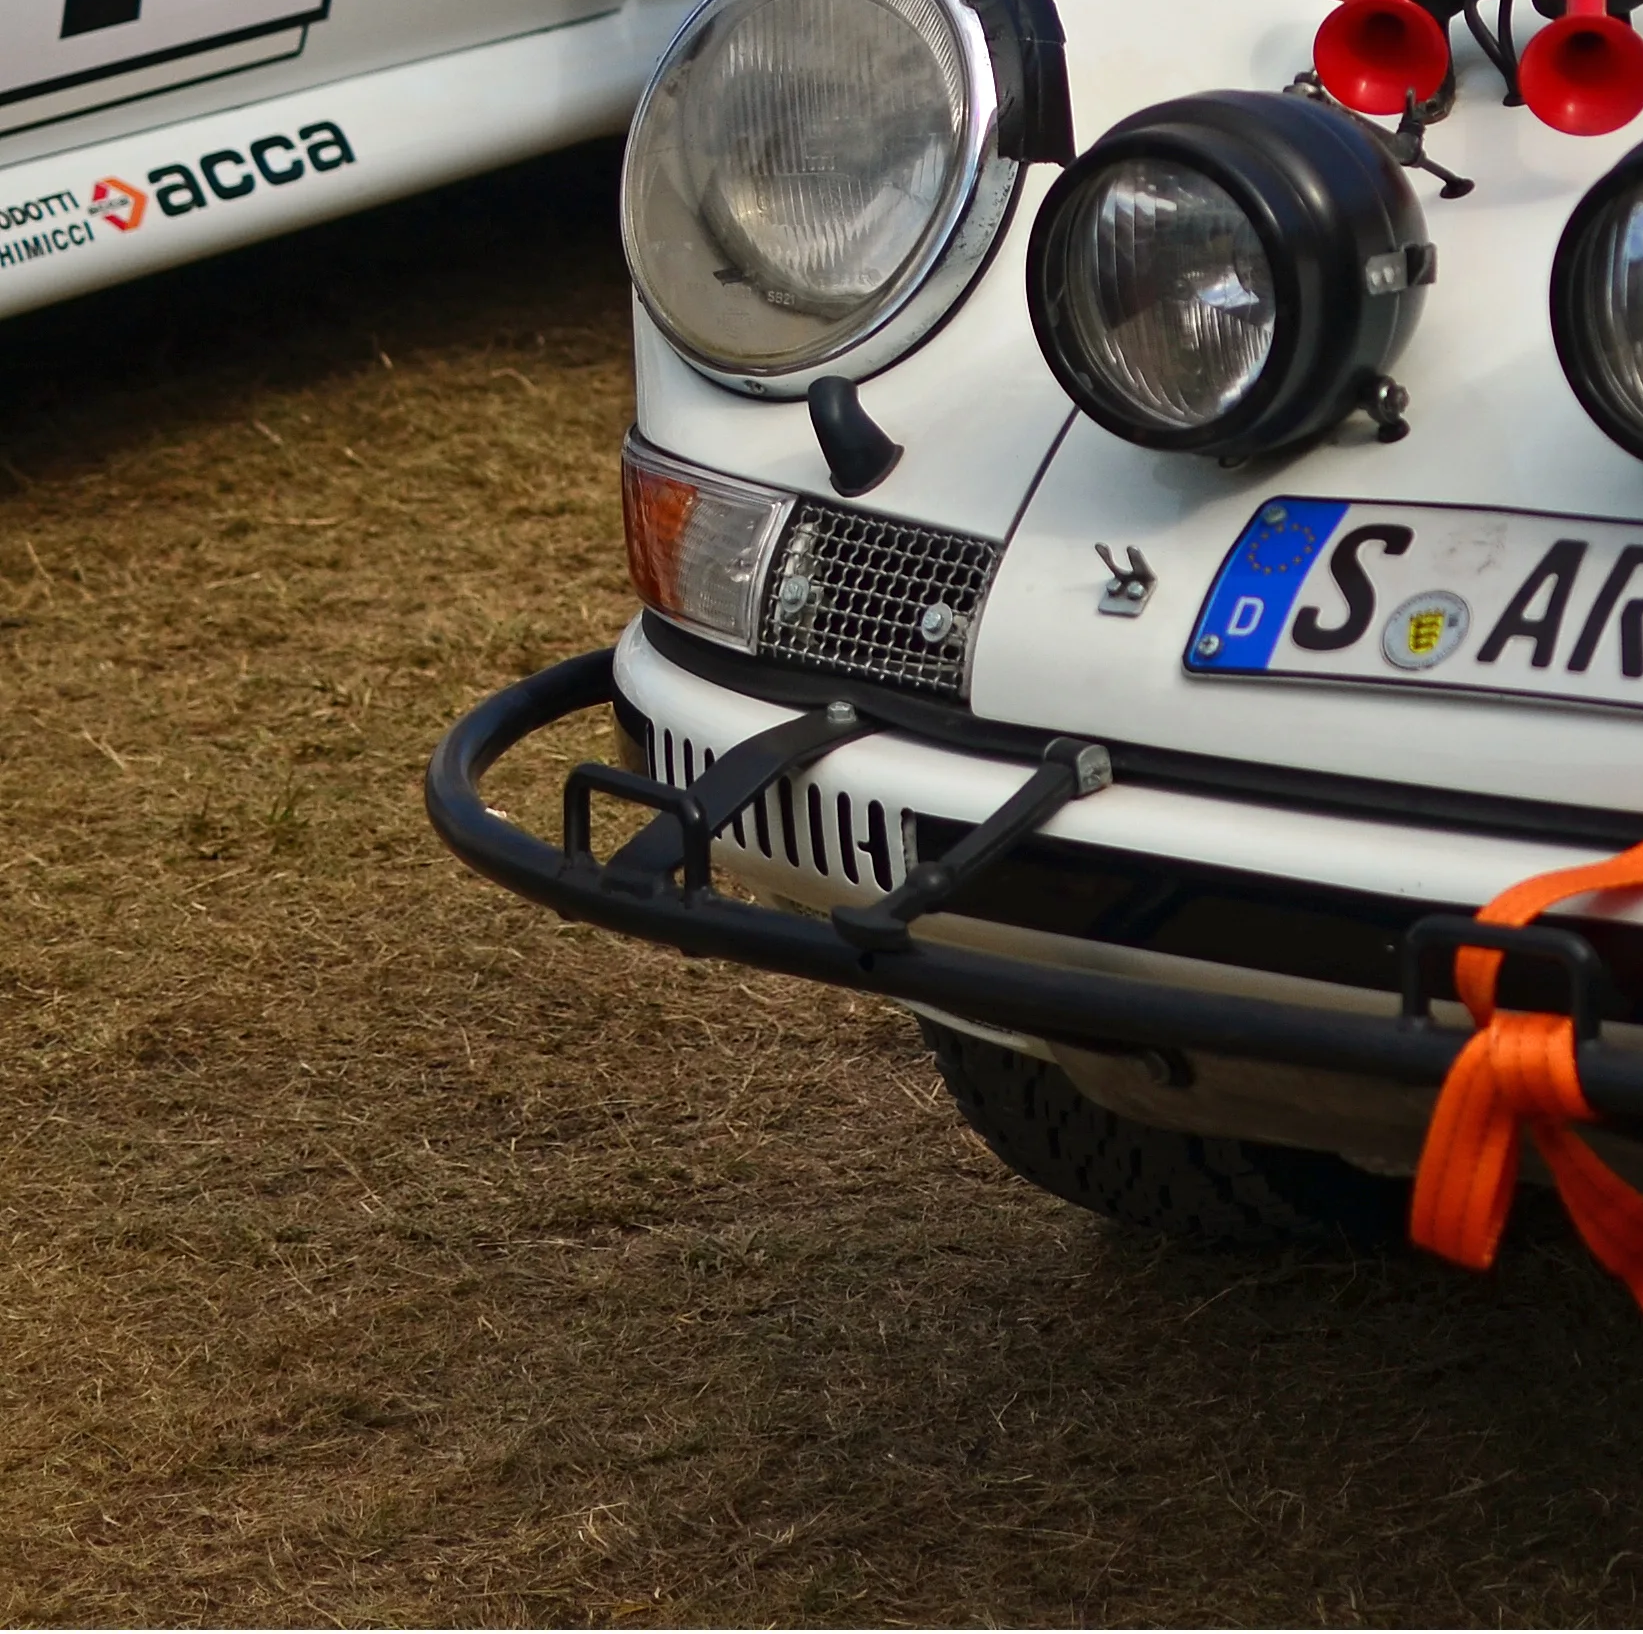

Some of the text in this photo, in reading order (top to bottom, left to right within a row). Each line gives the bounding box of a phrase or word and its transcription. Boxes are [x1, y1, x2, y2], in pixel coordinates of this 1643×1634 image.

[148, 120, 357, 217] acca
[1226, 596, 1264, 639] D
[1291, 523, 1415, 653] S
